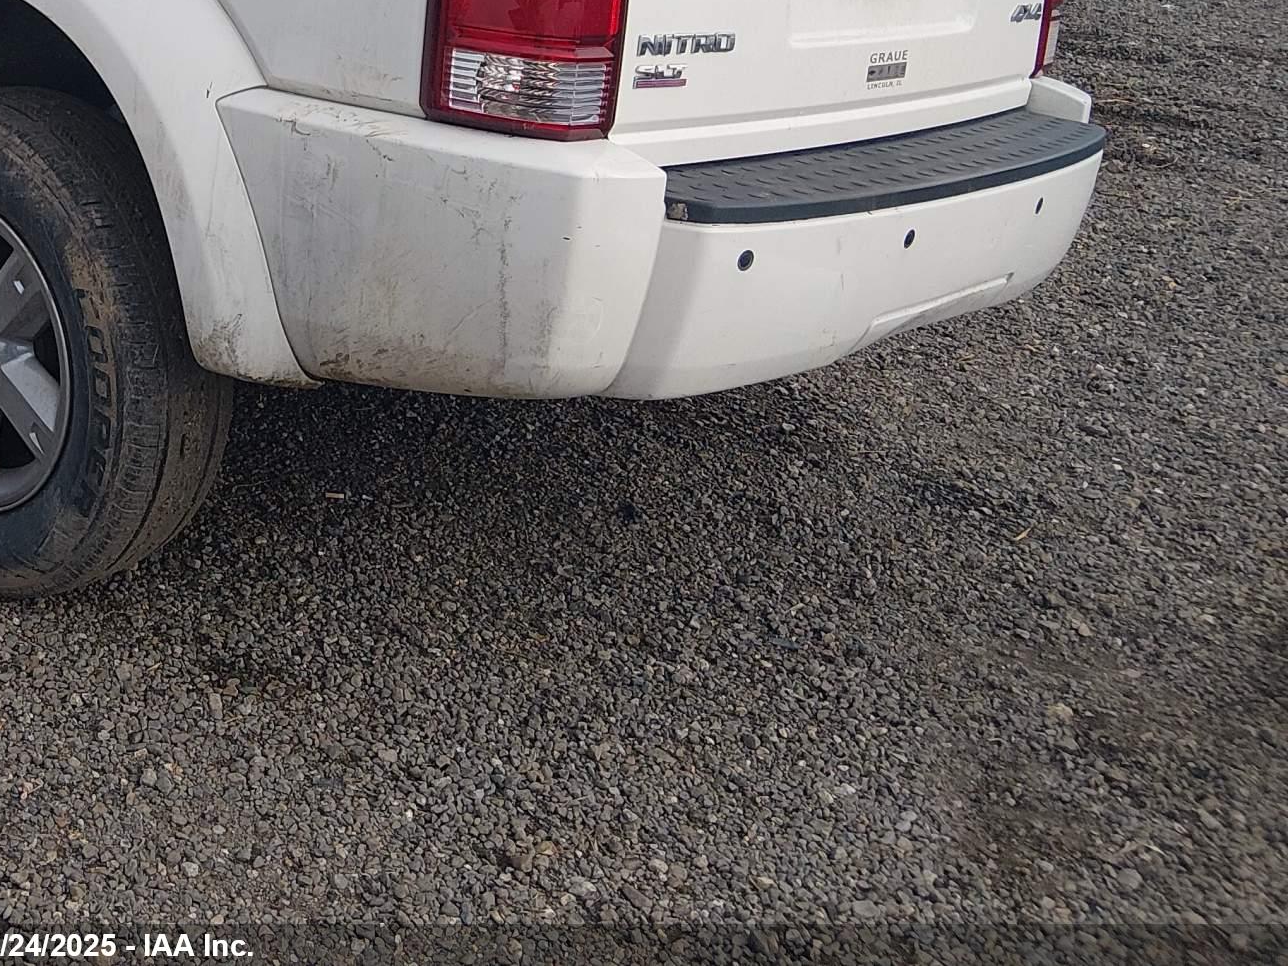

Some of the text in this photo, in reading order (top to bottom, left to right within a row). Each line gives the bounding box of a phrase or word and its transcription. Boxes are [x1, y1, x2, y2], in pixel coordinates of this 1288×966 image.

[637, 32, 736, 57] NITRO
[870, 49, 909, 64] GRAUE
[634, 63, 688, 80] SLT
